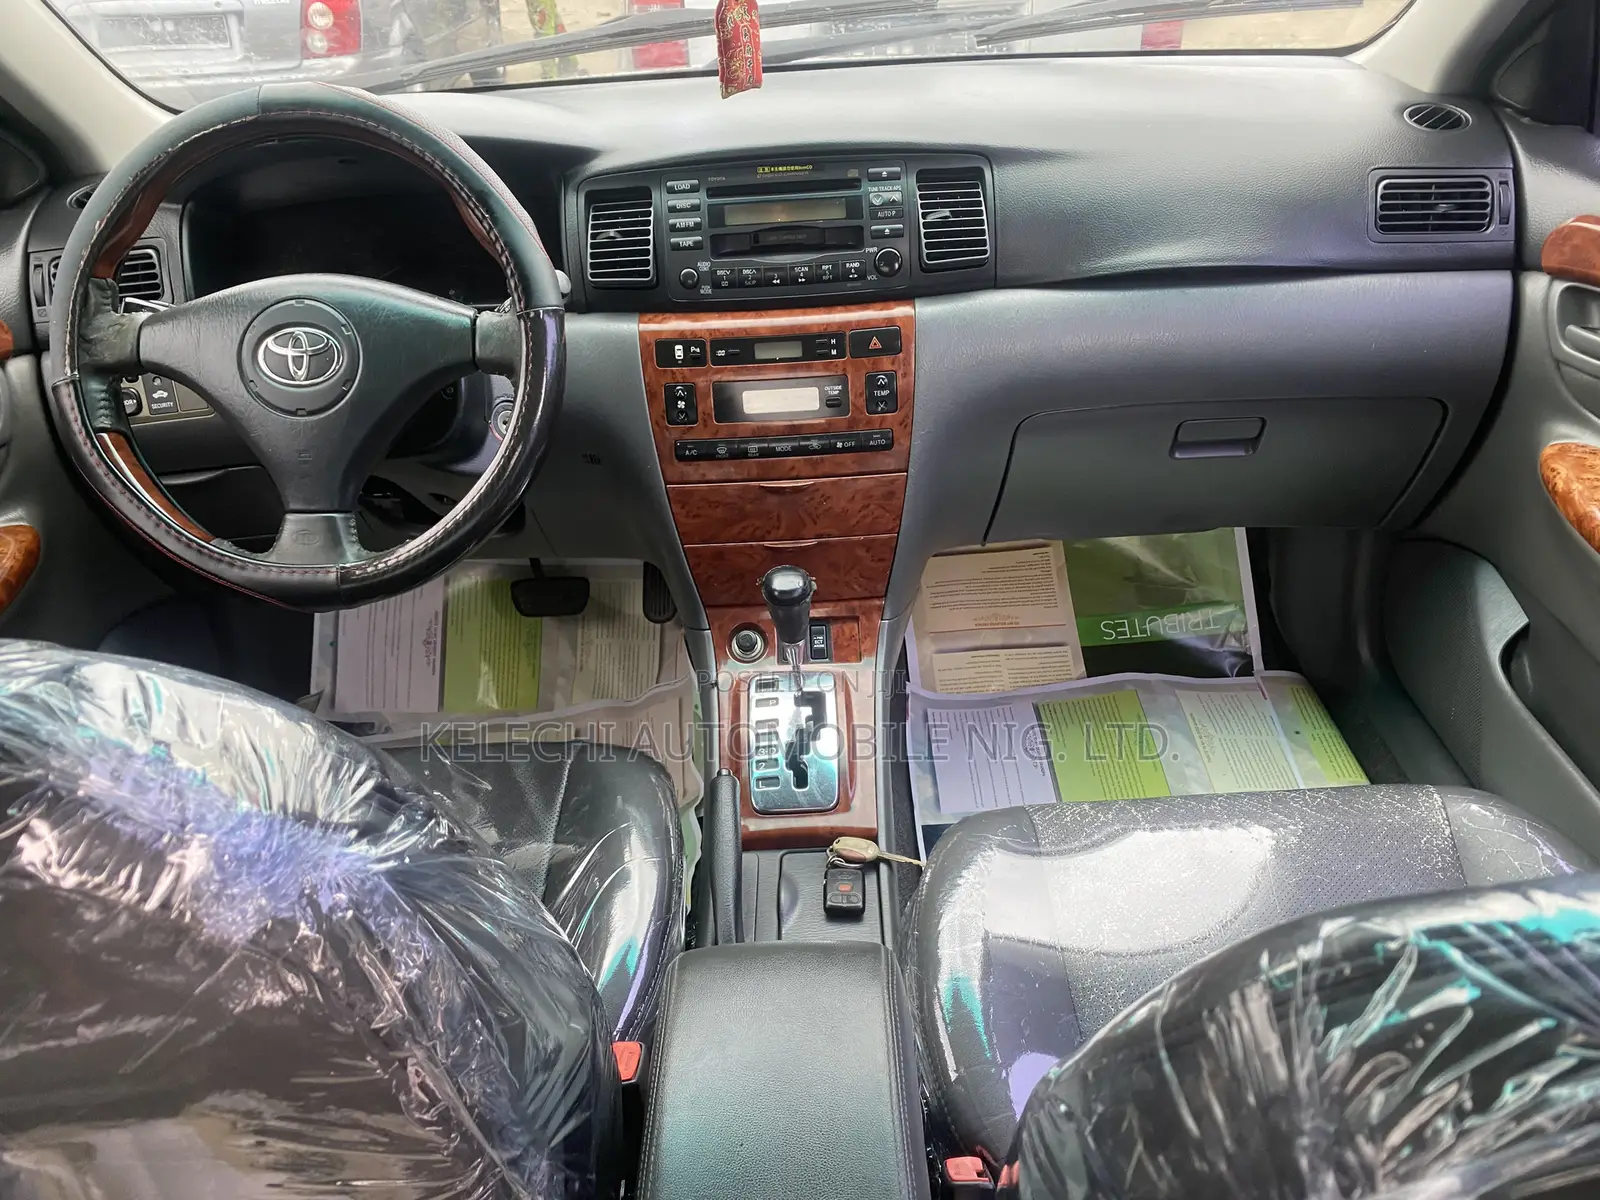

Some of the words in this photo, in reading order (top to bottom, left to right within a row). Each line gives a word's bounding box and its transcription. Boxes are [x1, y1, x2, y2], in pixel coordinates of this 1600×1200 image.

[674, 183, 691, 191] LOAD
[873, 389, 890, 397] TEMP
[151, 401, 174, 410] SECURITY
[869, 438, 886, 446] AUTO
[1100, 609, 1221, 640] TRIBUTES
[758, 762, 766, 771] 2
[759, 780, 766, 788] L
